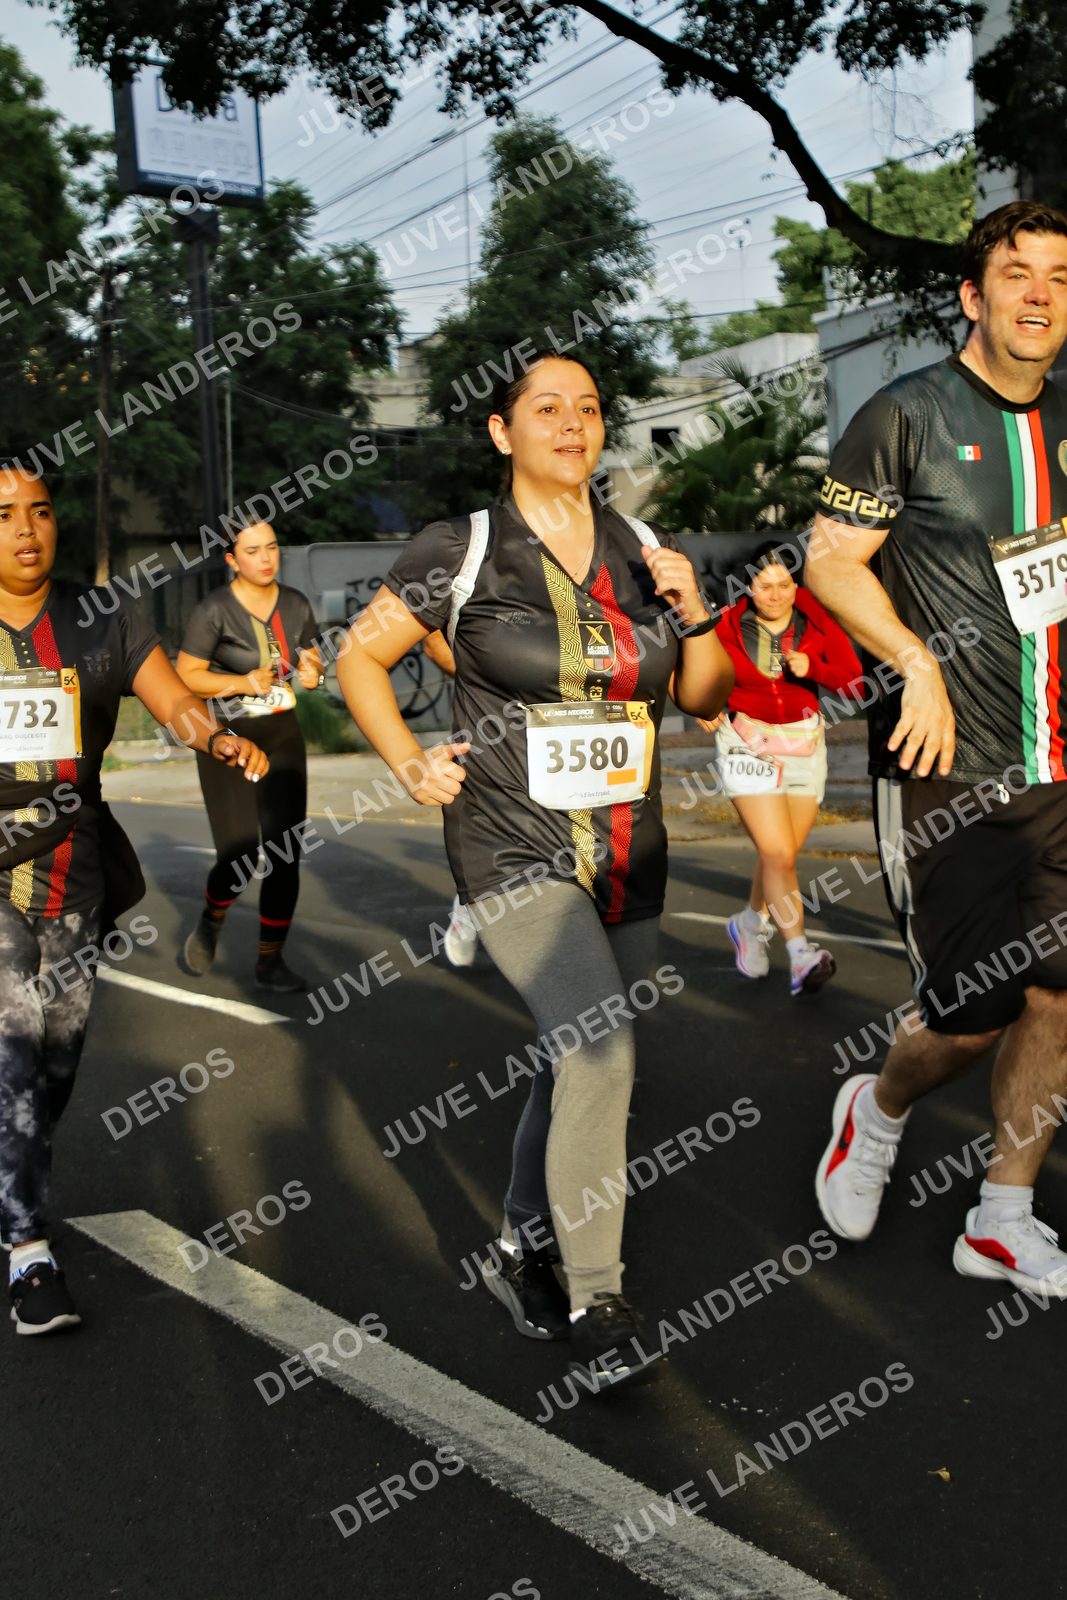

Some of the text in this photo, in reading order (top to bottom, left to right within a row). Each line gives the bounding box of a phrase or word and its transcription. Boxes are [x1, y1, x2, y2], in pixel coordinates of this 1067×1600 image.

[1013, 553, 1067, 599] 3579
[546, 736, 629, 774] 3580
[728, 761, 775, 777] 10005
